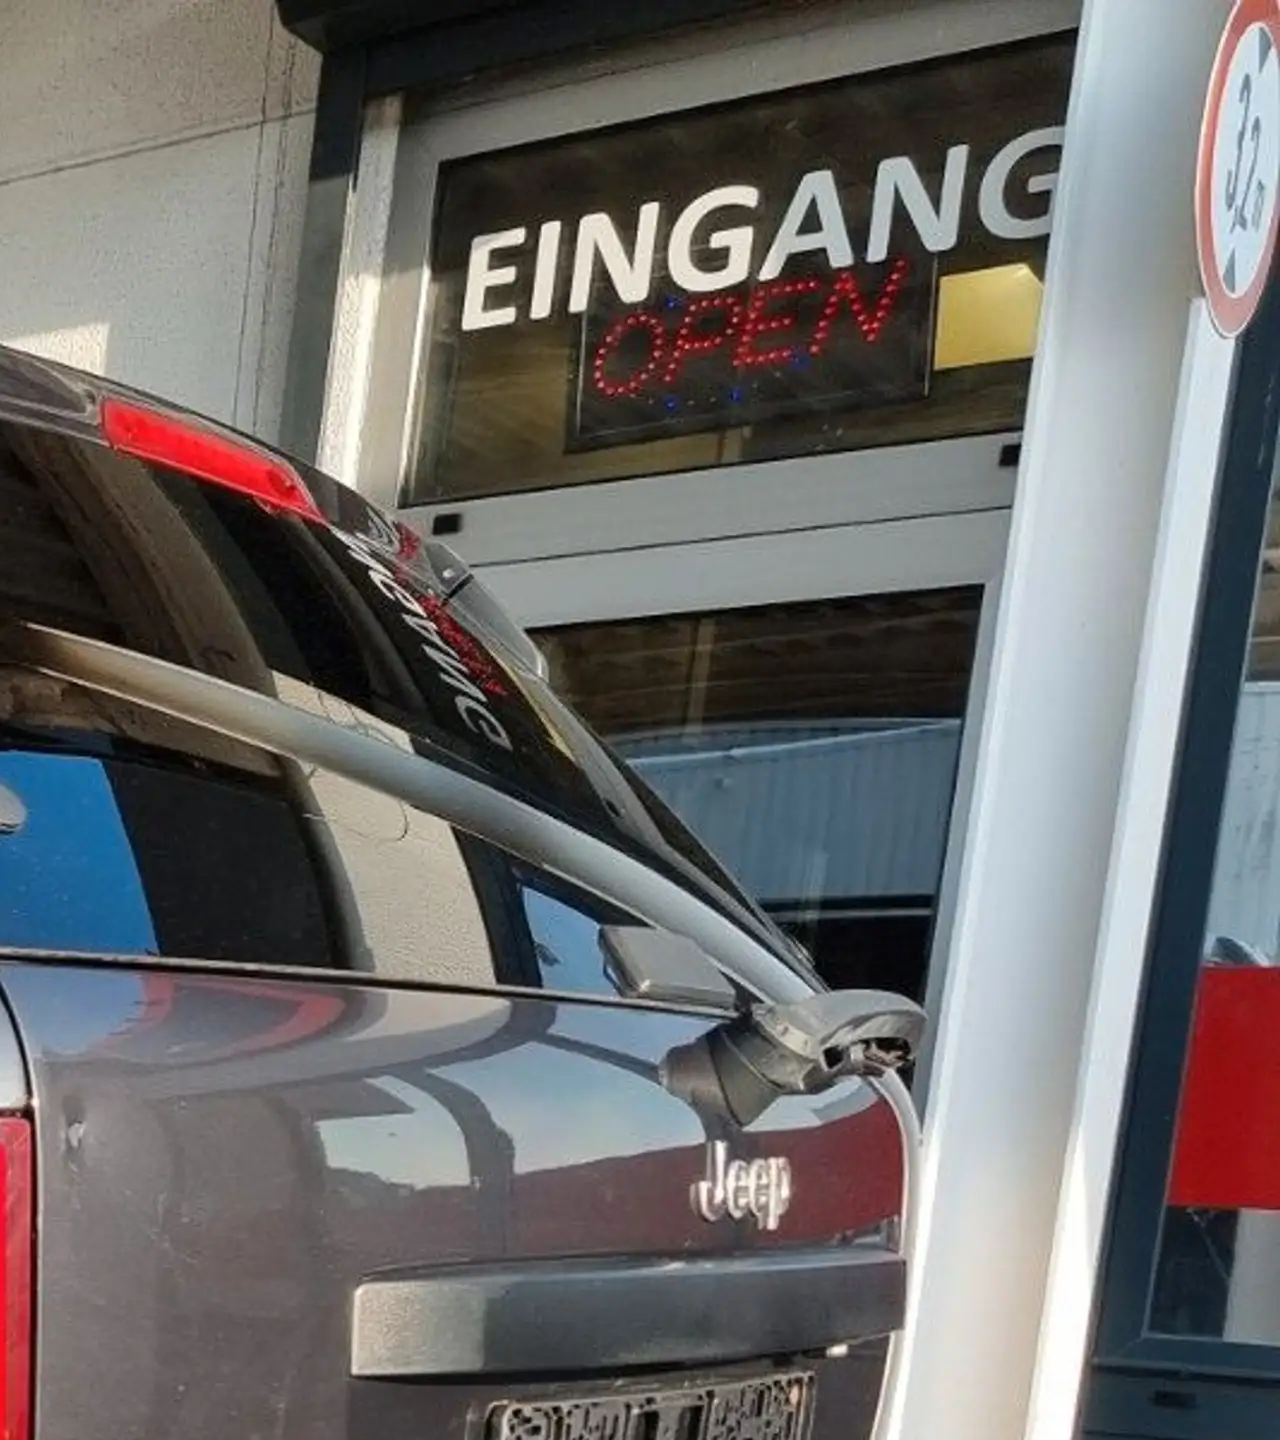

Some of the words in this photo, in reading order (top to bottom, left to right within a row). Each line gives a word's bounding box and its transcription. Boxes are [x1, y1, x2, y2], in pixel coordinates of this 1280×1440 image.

[461, 126, 1070, 332] EINGANG
[592, 250, 911, 398] OPEN
[690, 1139, 792, 1230] Jeep
